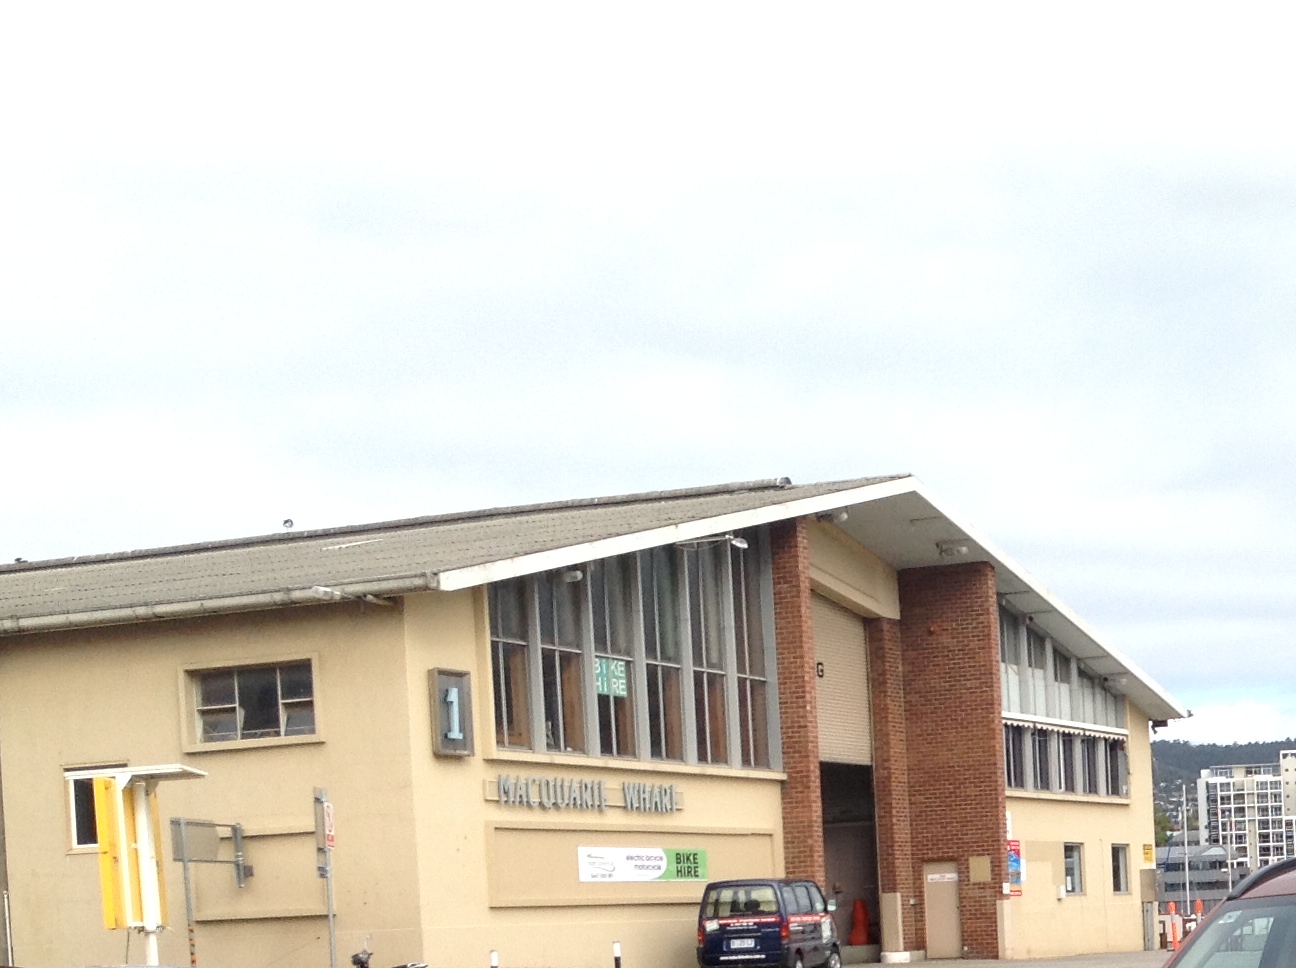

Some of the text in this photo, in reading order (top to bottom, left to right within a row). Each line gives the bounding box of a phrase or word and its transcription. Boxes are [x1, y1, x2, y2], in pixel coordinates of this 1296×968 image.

[816, 661, 824, 678] G
[443, 687, 464, 739] 1
[498, 775, 677, 813] MACQUARIE WHARF
[675, 852, 699, 865] BIKE
[676, 865, 700, 878] HIRE
